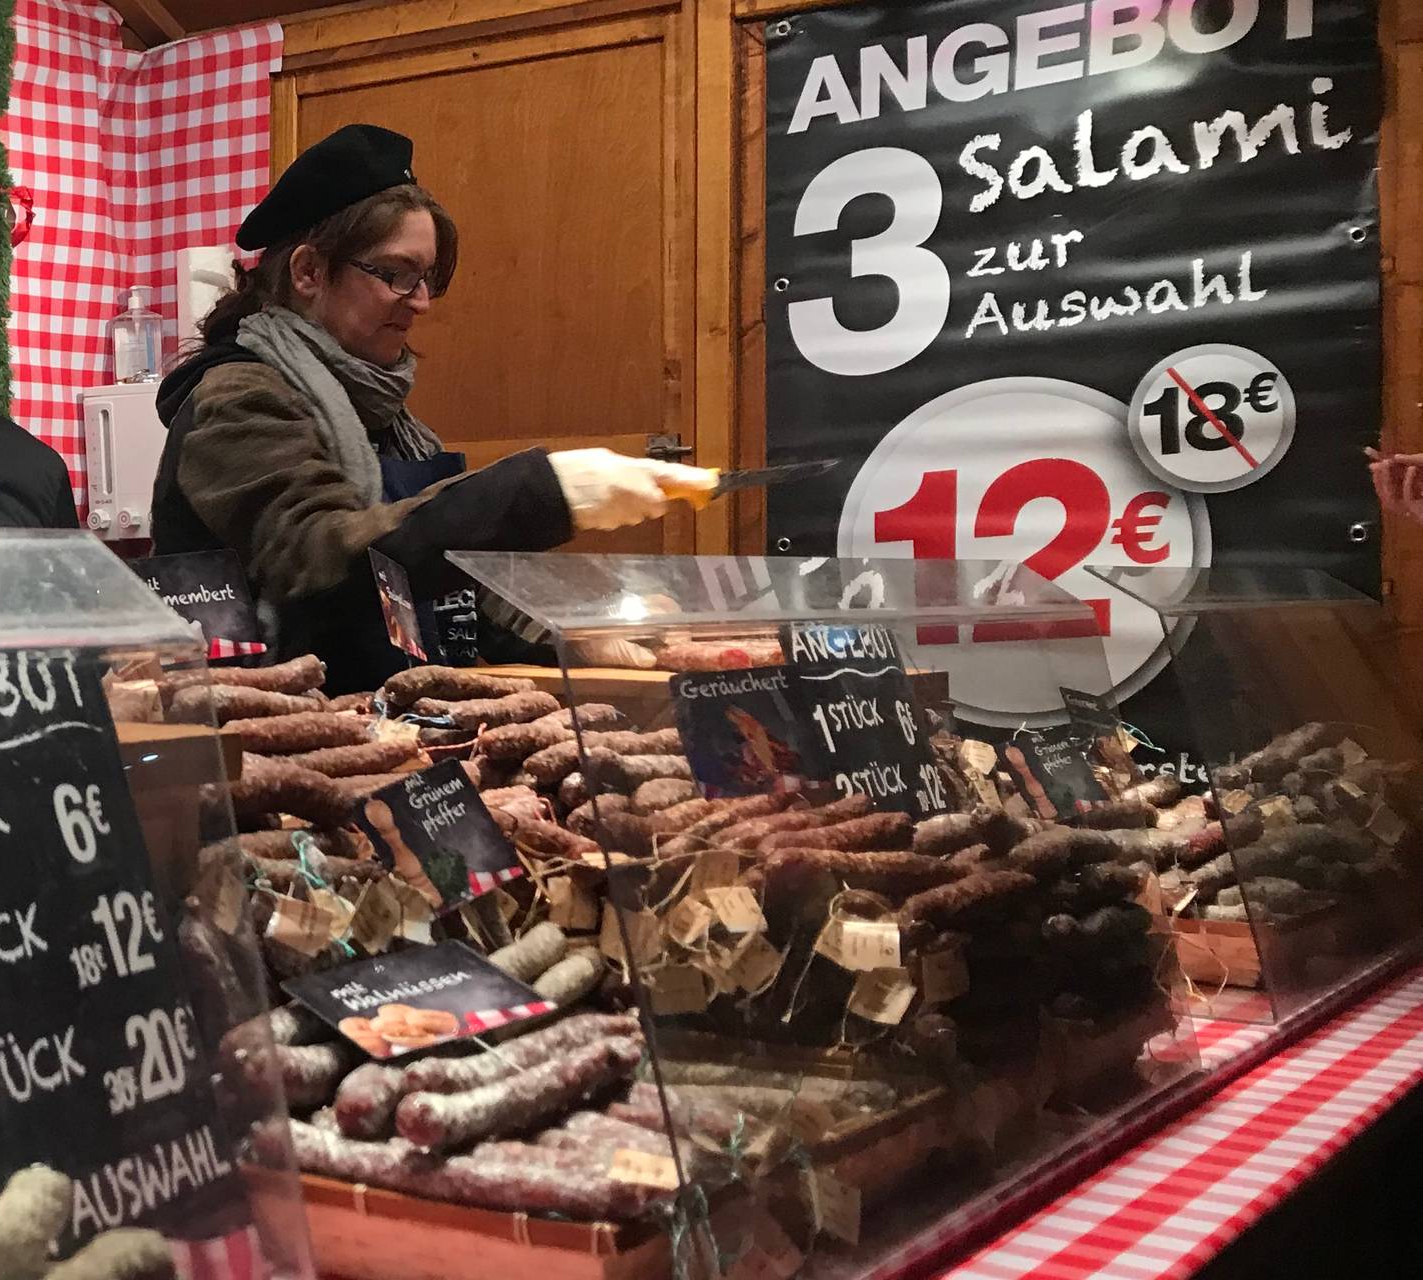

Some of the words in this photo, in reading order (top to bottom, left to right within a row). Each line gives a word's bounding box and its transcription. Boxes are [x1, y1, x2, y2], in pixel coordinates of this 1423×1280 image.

[787, 147, 951, 377] 3
[958, 76, 1352, 214] Salami
[966, 226, 1085, 279] zur
[965, 250, 1269, 339] Auswahl
[1143, 371, 1281, 455] 18€
[874, 457, 1173, 646] 12€
[163, 583, 236, 606] membert
[679, 671, 789, 700] Geräuchert
[813, 703, 837, 753] 1
[829, 692, 885, 733] STÜCK
[408, 777, 465, 809] Grünem
[851, 762, 908, 798] STÜCK
[52, 782, 111, 864] 6€
[91, 890, 164, 978] 12€
[330, 980, 369, 1000] mit
[73, 1124, 232, 1240] AUSWAHL
